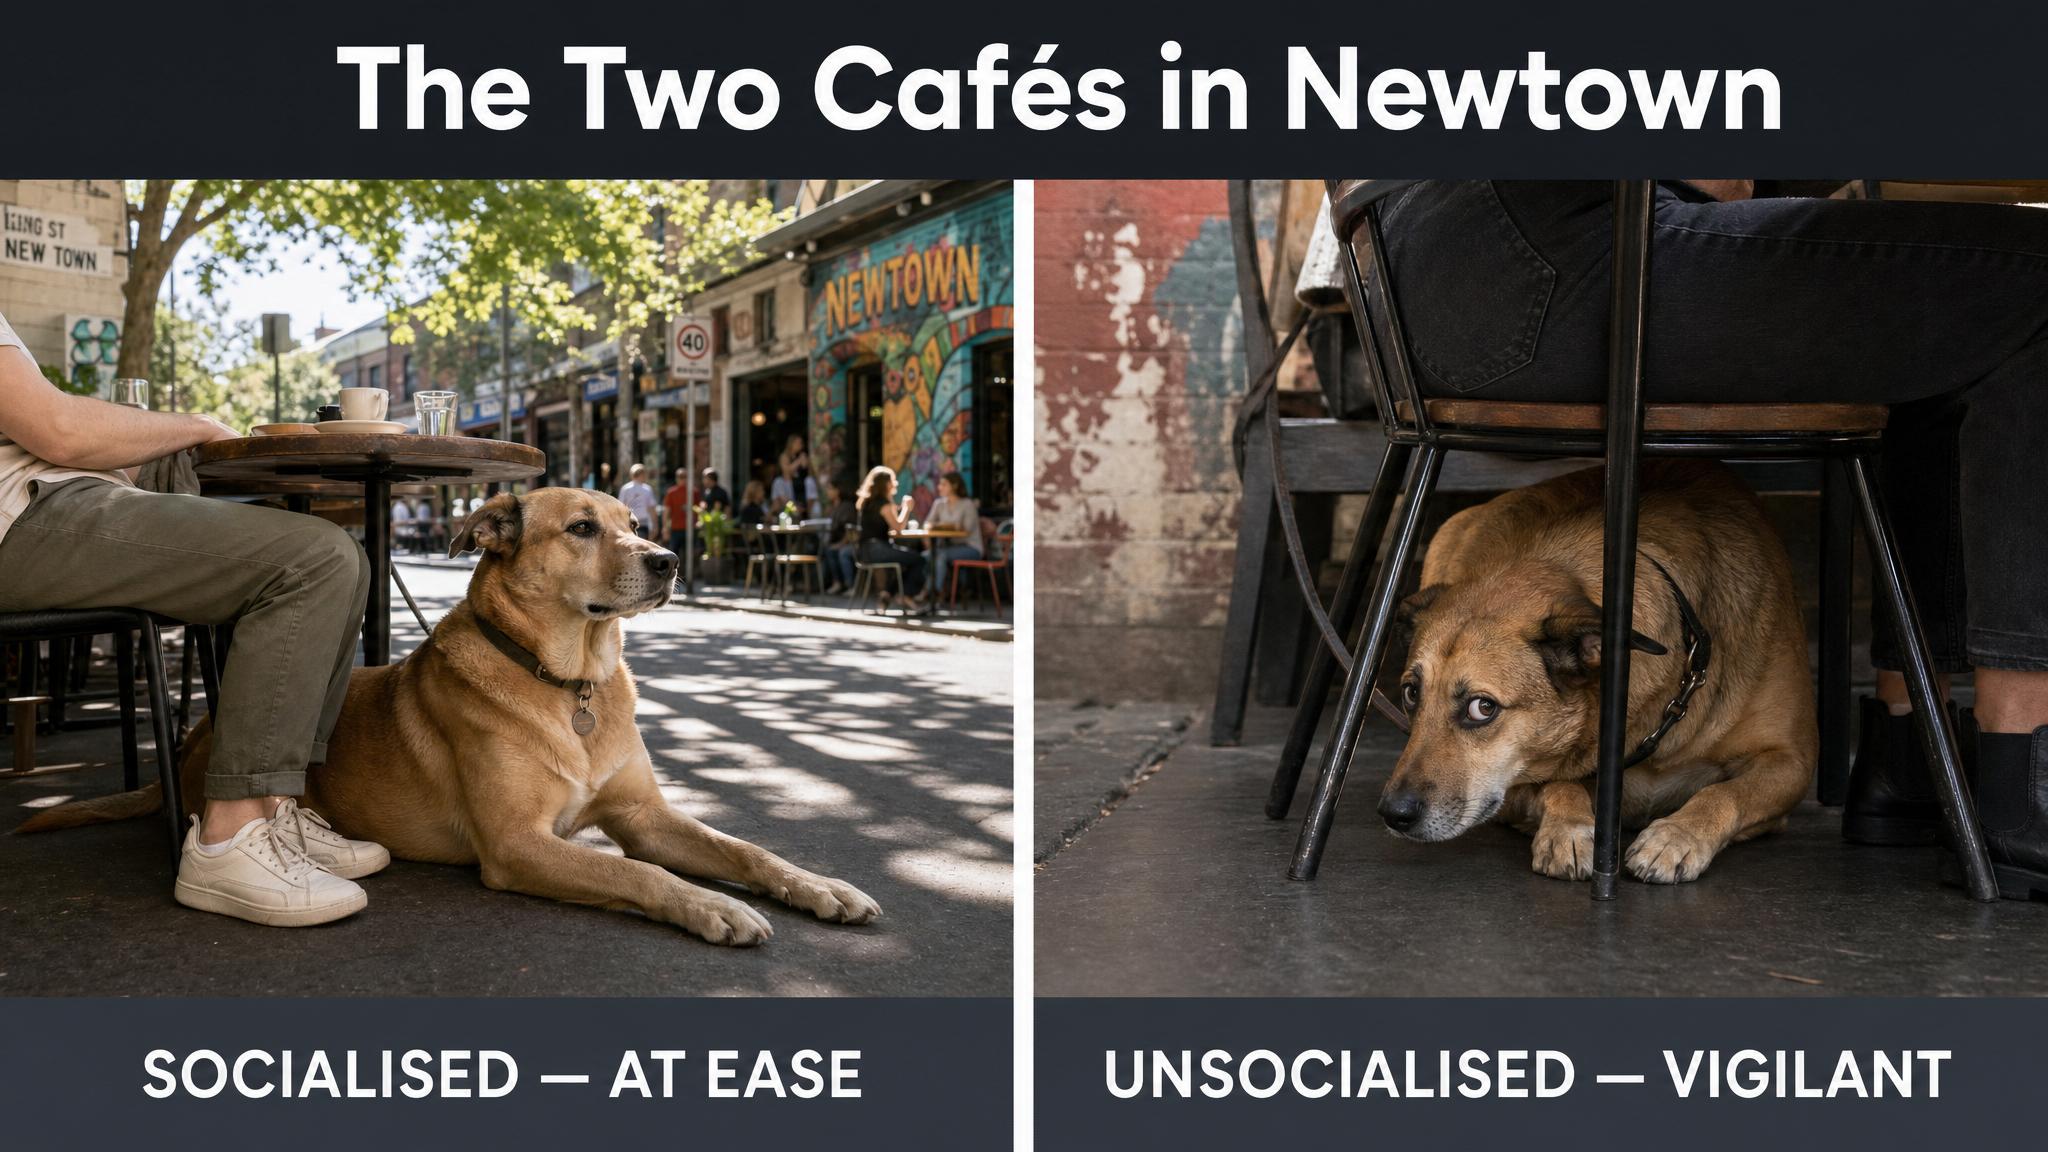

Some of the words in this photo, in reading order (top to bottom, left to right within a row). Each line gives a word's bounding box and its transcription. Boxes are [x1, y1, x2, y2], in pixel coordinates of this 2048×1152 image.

[48, 220, 66, 239] ST
[5, 238, 46, 262] NEW
[53, 245, 97, 271] TOWN
[826, 244, 980, 336] NEWTOWN
[683, 334, 704, 351] 40
